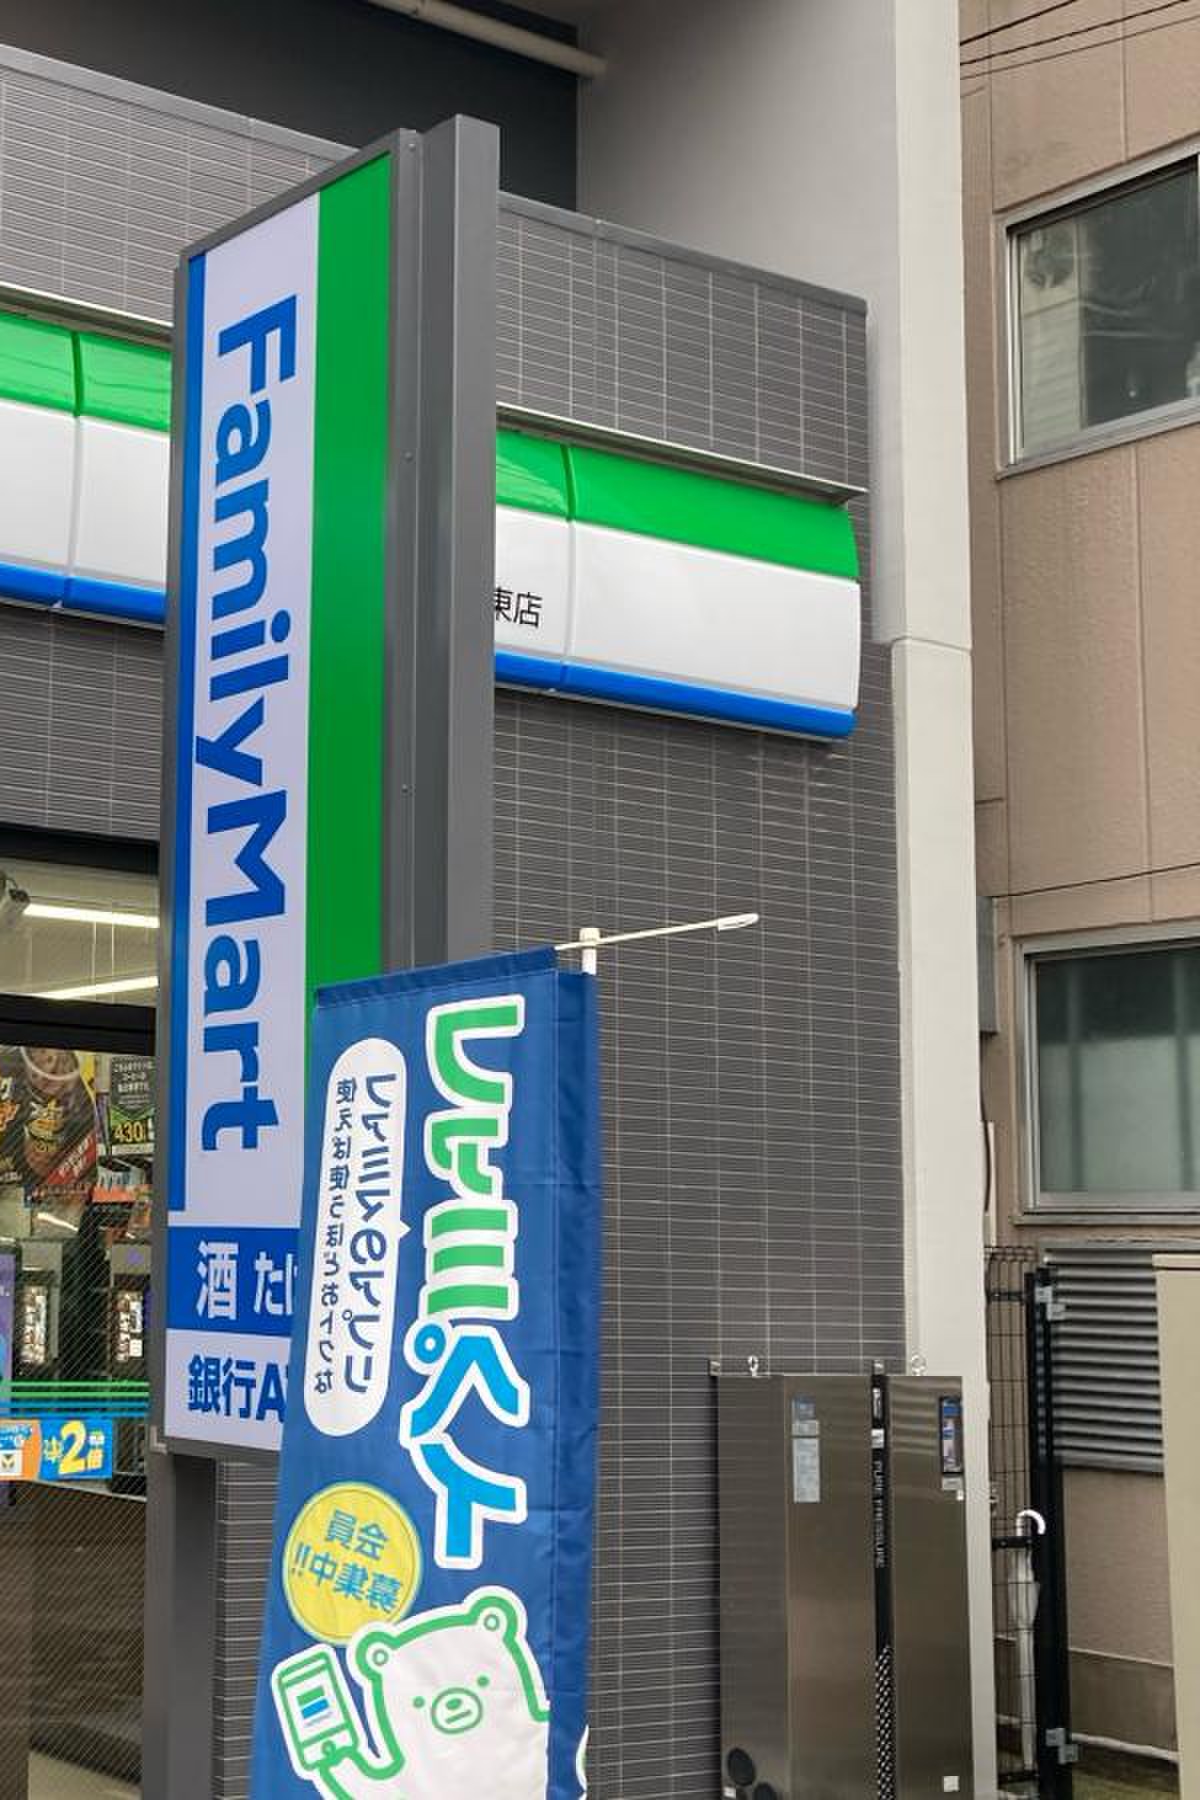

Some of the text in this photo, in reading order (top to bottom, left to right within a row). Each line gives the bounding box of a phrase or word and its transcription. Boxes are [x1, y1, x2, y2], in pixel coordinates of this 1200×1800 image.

[195, 294, 298, 1151] FamilyMart
[196, 1240, 238, 1320] 酒
[188, 1354, 289, 1422] 銀行A
